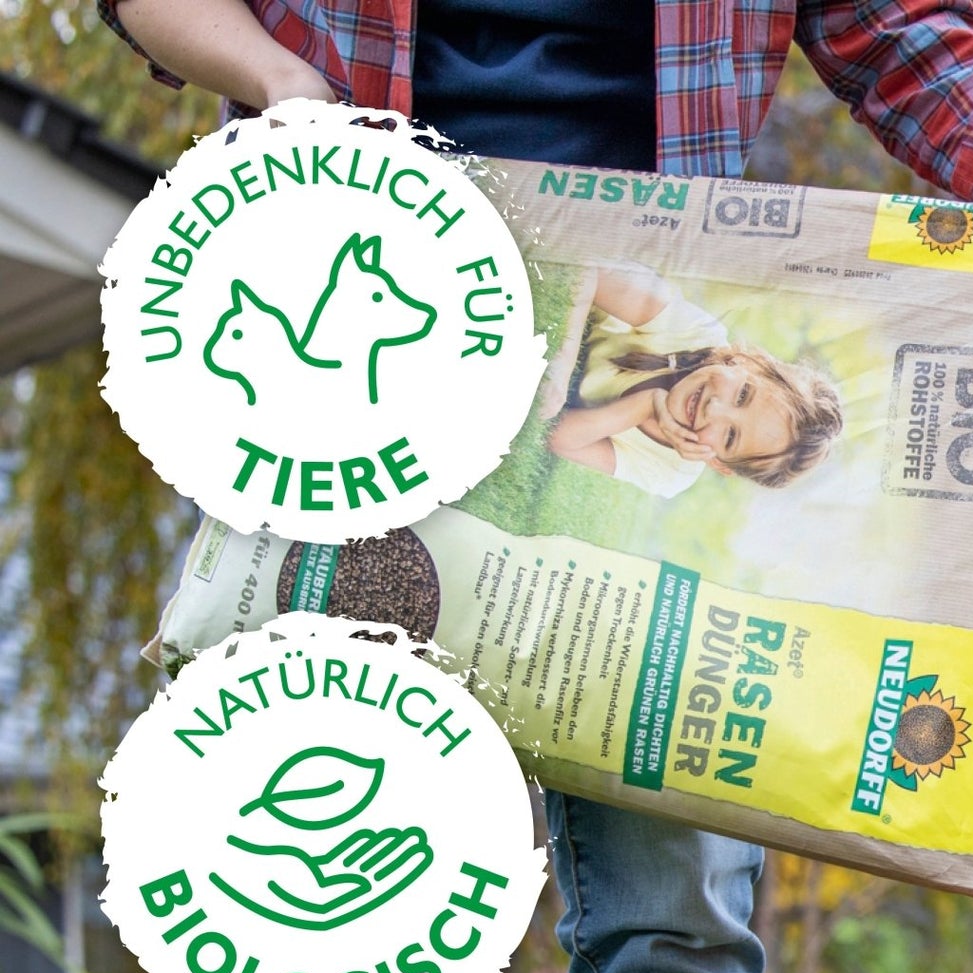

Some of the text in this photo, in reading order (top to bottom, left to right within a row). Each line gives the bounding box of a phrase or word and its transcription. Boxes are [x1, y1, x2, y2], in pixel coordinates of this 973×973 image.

[538, 170, 689, 211] RASEN
[715, 196, 790, 228] BIO
[933, 362, 947, 388] 100
[903, 361, 932, 480] ROHSTOFFE
[922, 403, 941, 481] natürliche
[251, 536, 270, 569] für
[297, 544, 320, 611] ELTE AUSBRI
[308, 546, 334, 613] TAUBFR
[487, 556, 508, 599] geeignet
[528, 569, 541, 588] mit
[238, 573, 258, 615] 400
[476, 619, 491, 641] den
[483, 600, 496, 617] für
[494, 565, 527, 647] Langzeitwirkung
[512, 589, 536, 644] natürlicher
[521, 569, 559, 688] Bodendurchwurzelung
[502, 645, 520, 685] Sofort-
[534, 571, 574, 710] Mykorrhiza verbessert die
[549, 576, 594, 744] Boden und beugen Rasenfilz vor
[565, 581, 609, 741] Mikroorganismen beleben den
[598, 586, 628, 680] gegen Trockenheit
[598, 592, 644, 758] erhöht die Widerstandsfähigkeit
[630, 573, 678, 775] UND NATÜRLICH GRÜNEN RASEN
[645, 579, 693, 772] FÖRDERT NACHHALTIG DICHTEN
[674, 605, 740, 777] DÜNGER
[714, 616, 787, 789] RASEN
